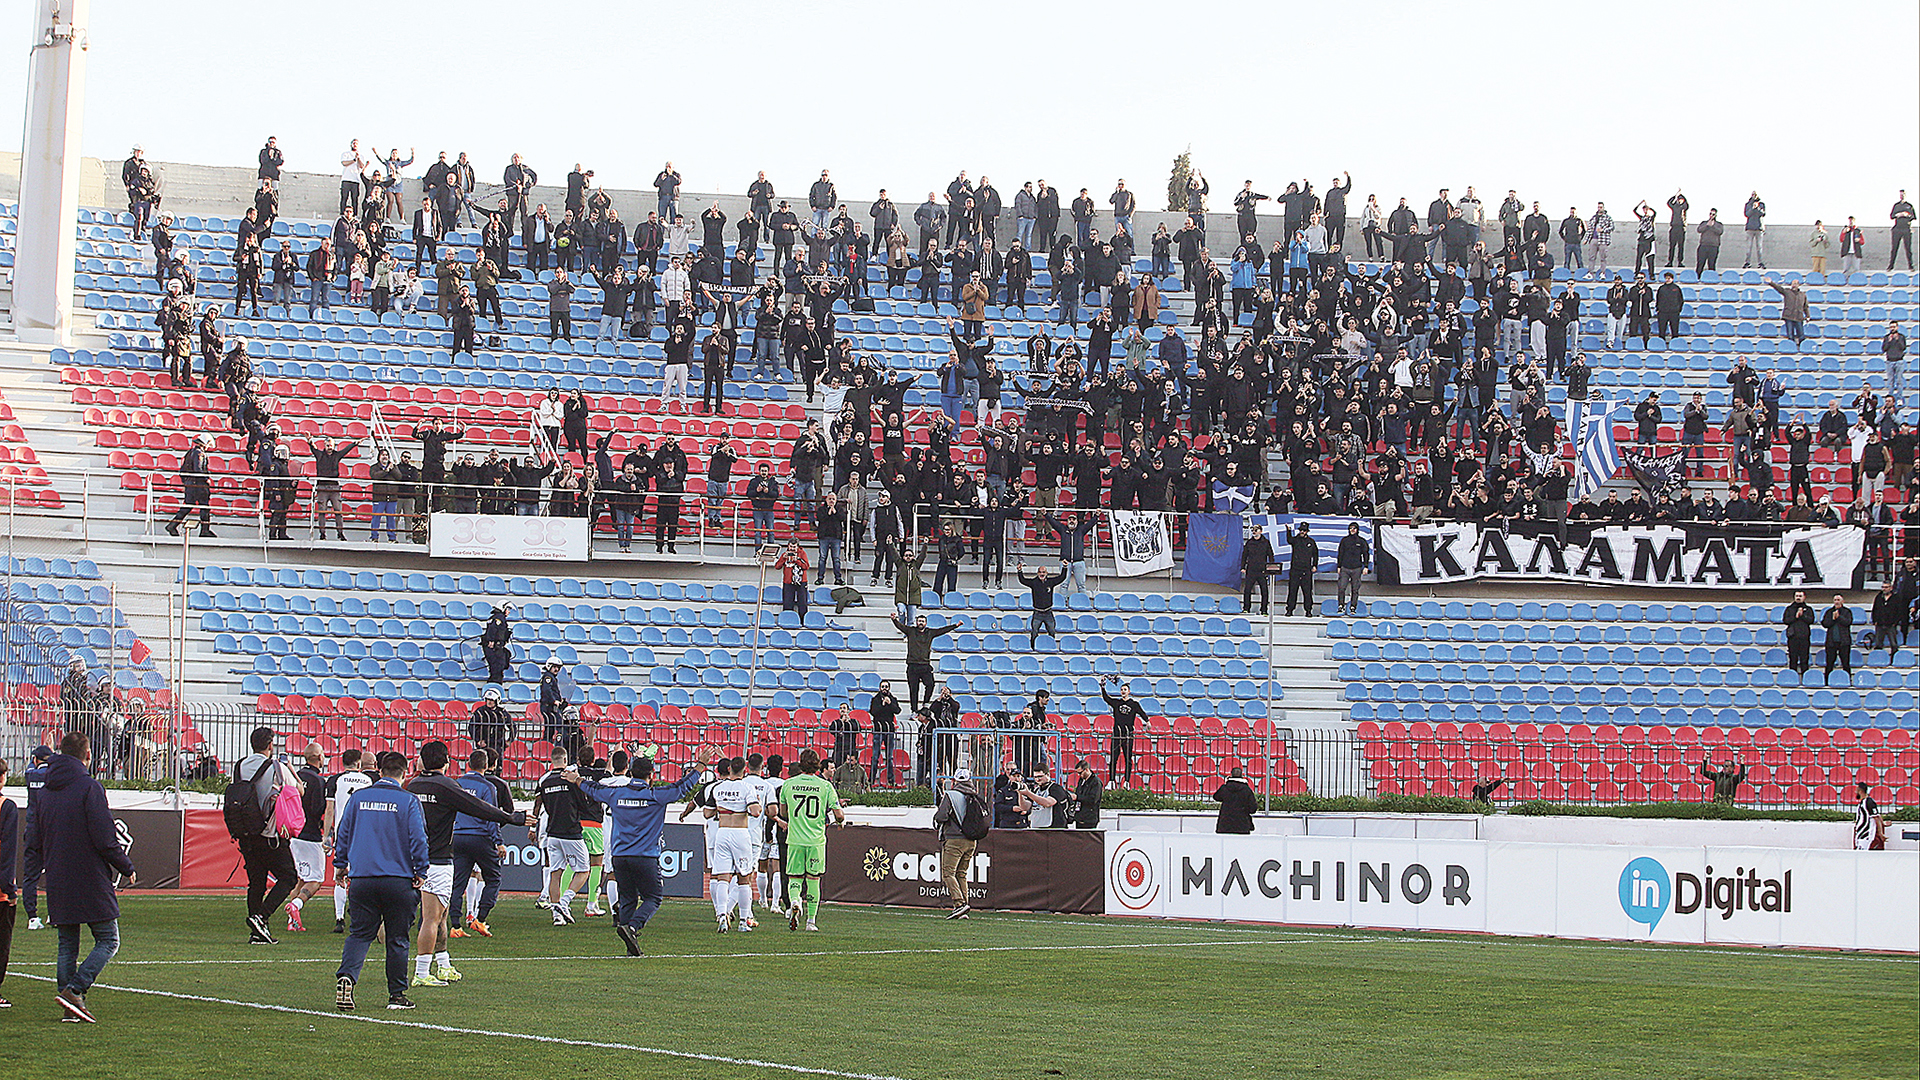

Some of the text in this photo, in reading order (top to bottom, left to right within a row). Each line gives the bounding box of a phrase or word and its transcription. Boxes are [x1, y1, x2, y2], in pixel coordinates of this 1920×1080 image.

[1414, 528, 1827, 584] ΚΑΛΑΜΑΤΑ
[793, 794, 820, 819] 70
[1182, 856, 1472, 906] MACHINOR
[1675, 865, 1792, 921] Digital
